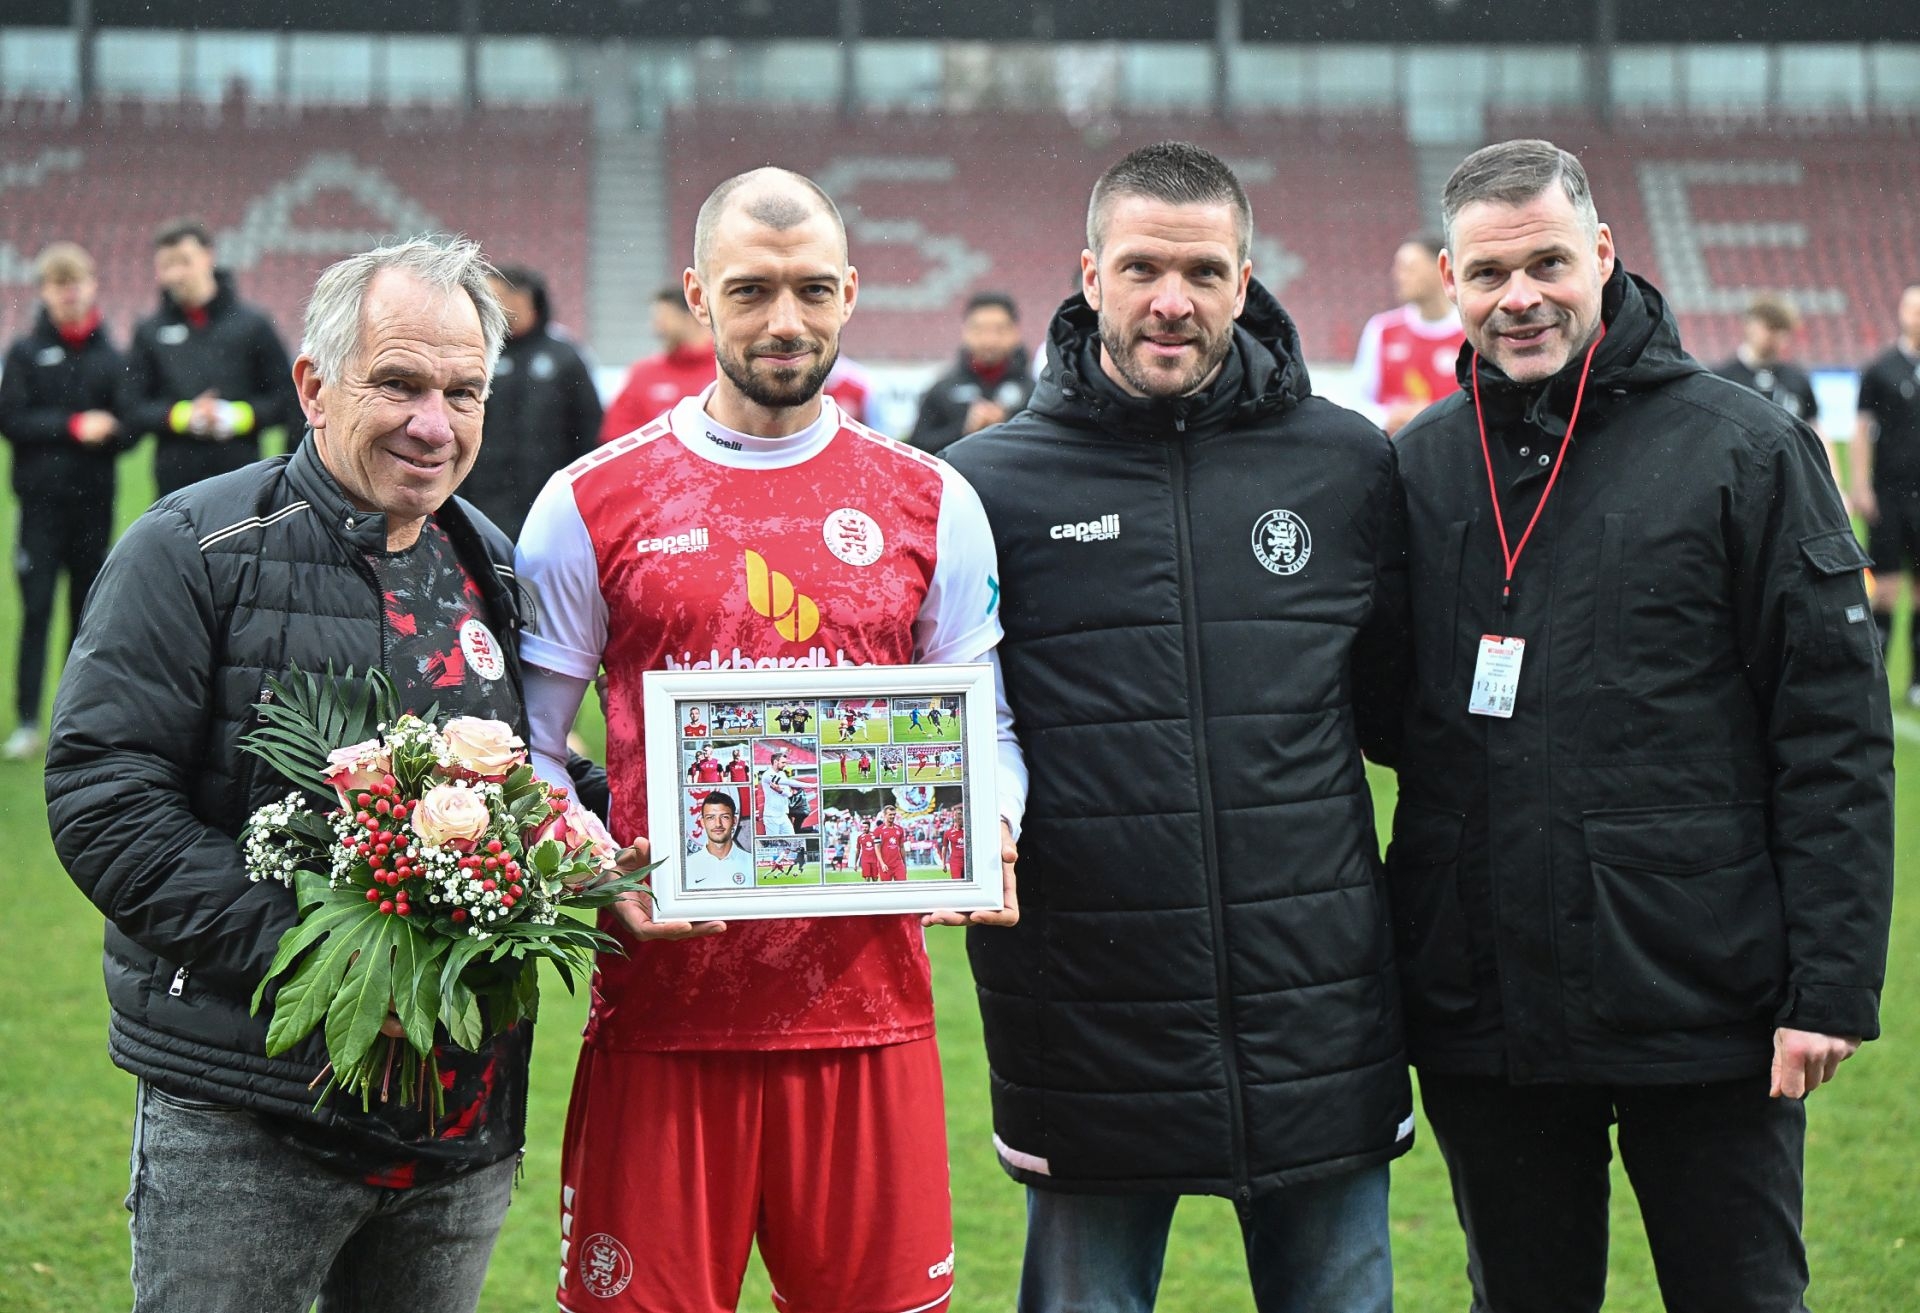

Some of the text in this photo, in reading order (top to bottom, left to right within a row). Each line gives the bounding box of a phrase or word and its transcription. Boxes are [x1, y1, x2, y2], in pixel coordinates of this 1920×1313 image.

[1638, 160, 1846, 314] E
[705, 430, 743, 451] capelli
[1049, 513, 1120, 542] capelli
[1082, 531, 1121, 543] SPORT
[636, 527, 709, 554] capelli
[669, 544, 709, 555] SPORT
